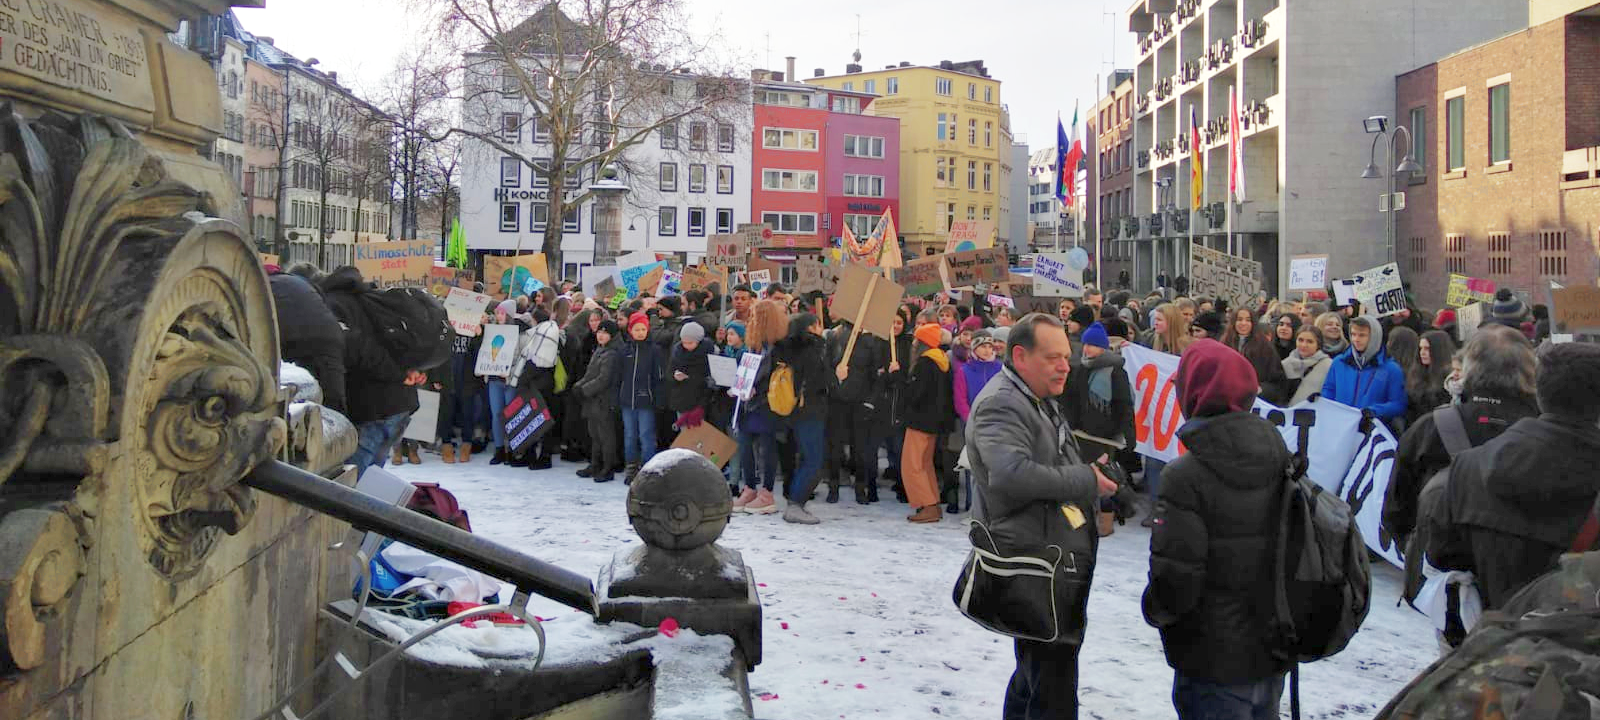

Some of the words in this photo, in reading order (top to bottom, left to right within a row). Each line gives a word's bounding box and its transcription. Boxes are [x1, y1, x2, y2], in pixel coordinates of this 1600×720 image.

[23, 20, 48, 46] DES
[511, 190, 569, 201] KONCT
[951, 230, 977, 239] TRASH
[1375, 287, 1407, 315] EARTH
[1135, 362, 1186, 457] 20
